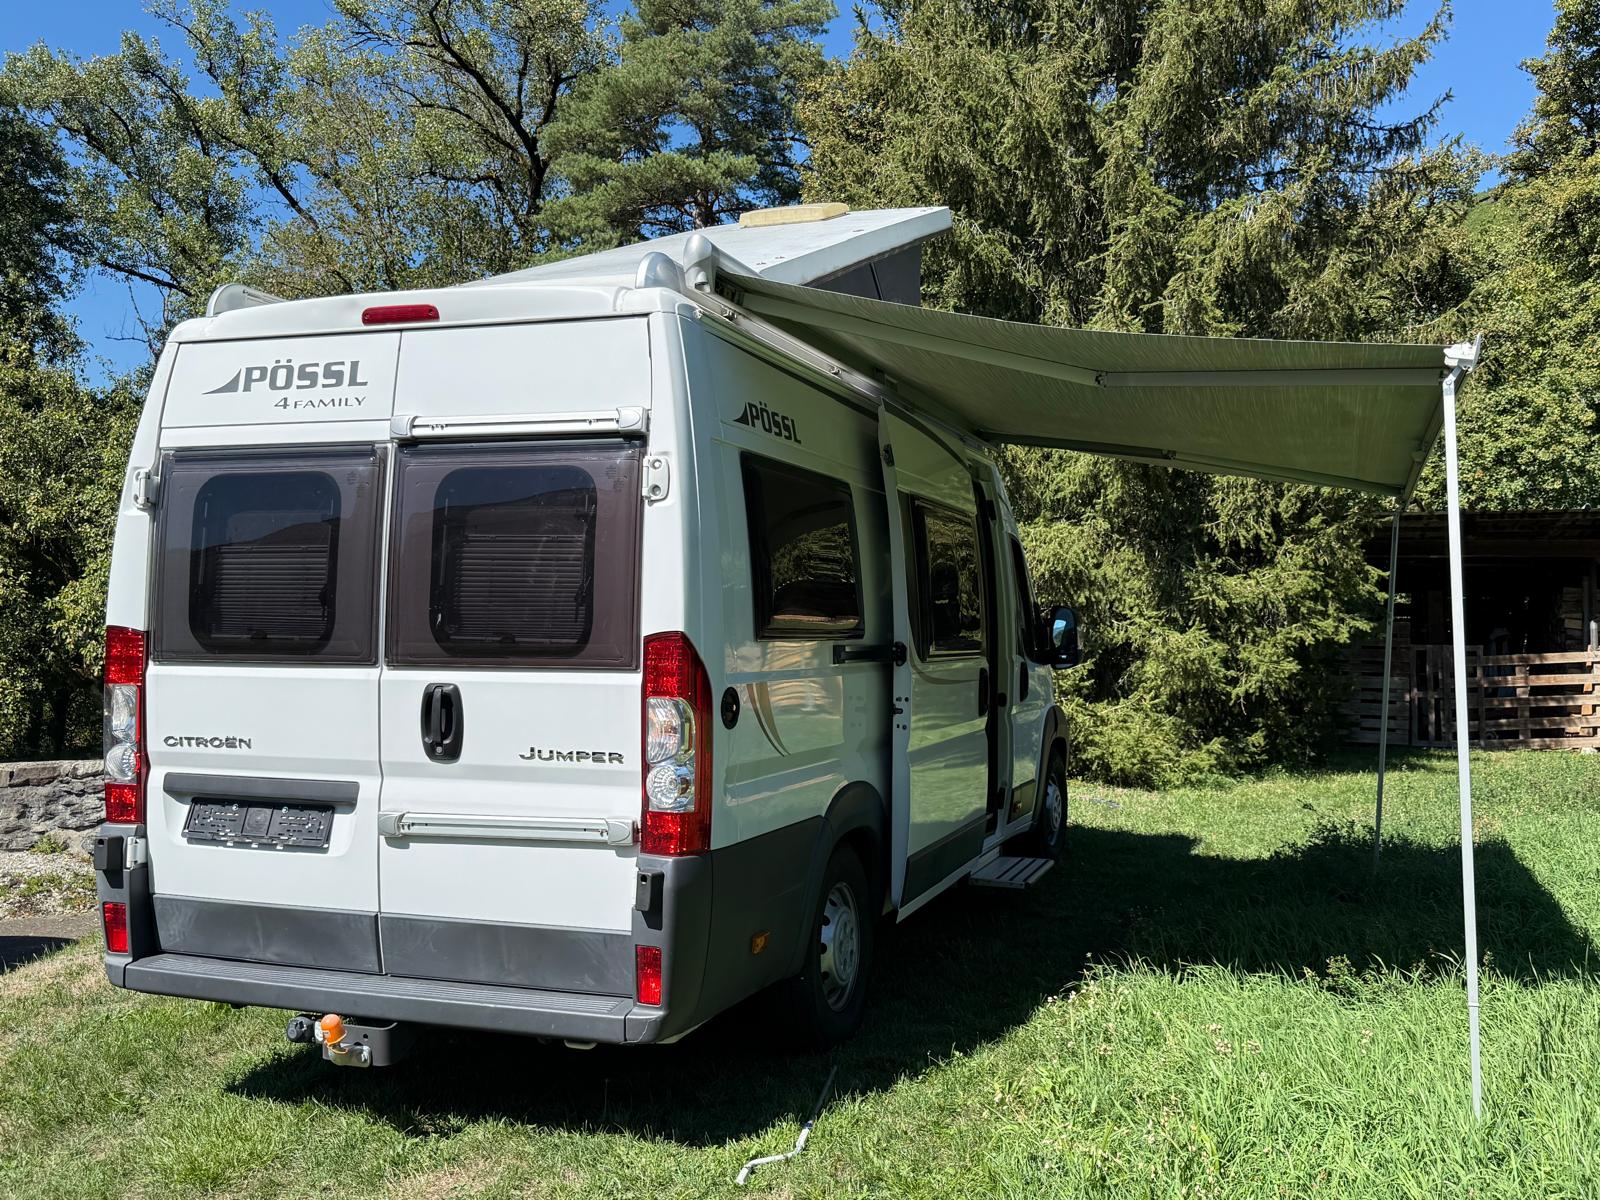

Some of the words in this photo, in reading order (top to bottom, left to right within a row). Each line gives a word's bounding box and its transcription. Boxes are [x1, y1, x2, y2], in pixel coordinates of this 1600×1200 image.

[242, 358, 369, 393] PÖSSL
[747, 400, 802, 445] PÖSSL
[163, 735, 252, 750] CITROËN
[518, 746, 625, 765] JUMPER
